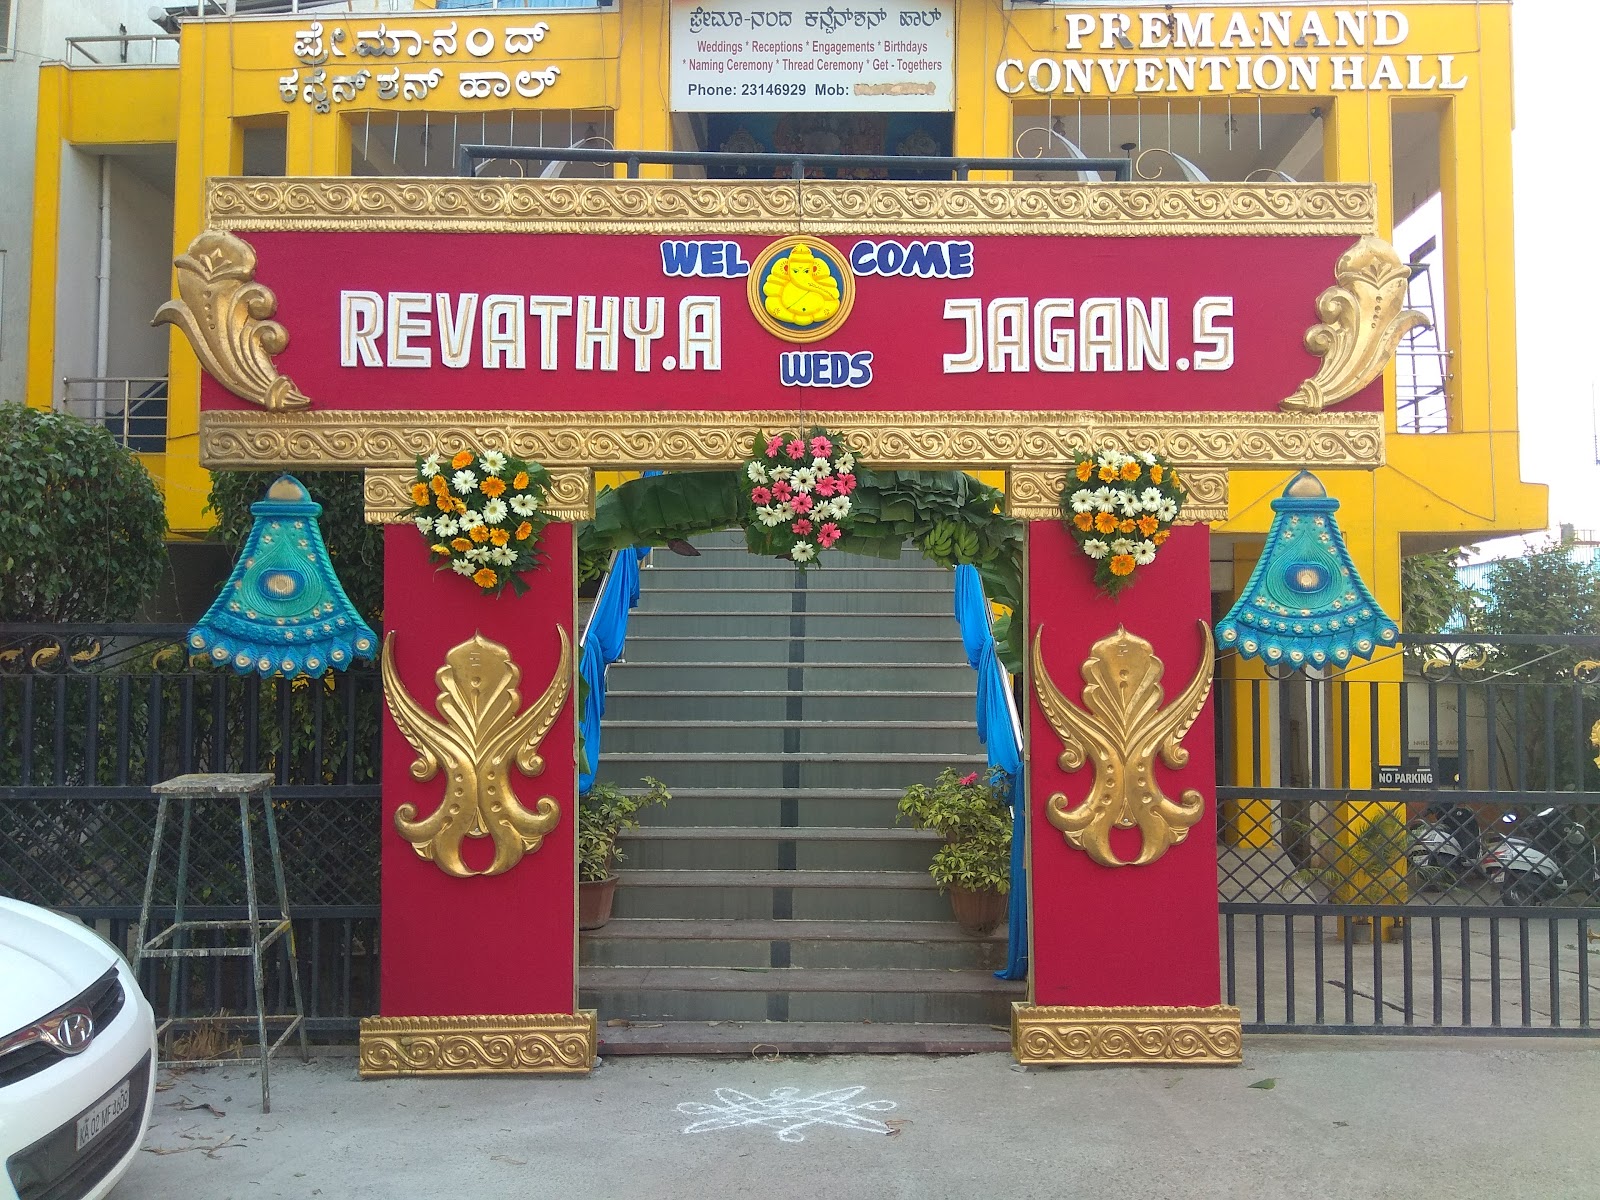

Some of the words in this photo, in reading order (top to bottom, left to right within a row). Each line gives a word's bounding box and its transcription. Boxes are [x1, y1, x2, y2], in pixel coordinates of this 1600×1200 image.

[899, 7, 942, 27] ಹಾಲ್
[689, 59, 724, 73] Naming
[726, 59, 774, 73] Ceremony
[782, 58, 814, 71] Thread
[816, 59, 864, 73] Ceremony
[872, 58, 889, 71] Get
[896, 58, 943, 73] Togethers
[697, 40, 743, 55] Weddings
[751, 40, 803, 55] Receptions
[812, 40, 875, 55] Engagements
[884, 40, 928, 55] Birthdays
[459, 65, 561, 98] ಹಾಲ್
[688, 83, 737, 96] Phone:
[741, 83, 806, 96] 23146929
[815, 83, 849, 96] Mob:
[995, 55, 1320, 94] CONVENTION
[1330, 55, 1469, 90] HALL
[660, 240, 750, 279] WEL
[850, 240, 975, 279] COME
[340, 289, 723, 373] REVATHY.A
[943, 296, 1235, 374] JAGAN.S
[779, 350, 874, 389] WEDS
[1379, 773, 1393, 783] NO
[1394, 773, 1433, 784] PARKING
